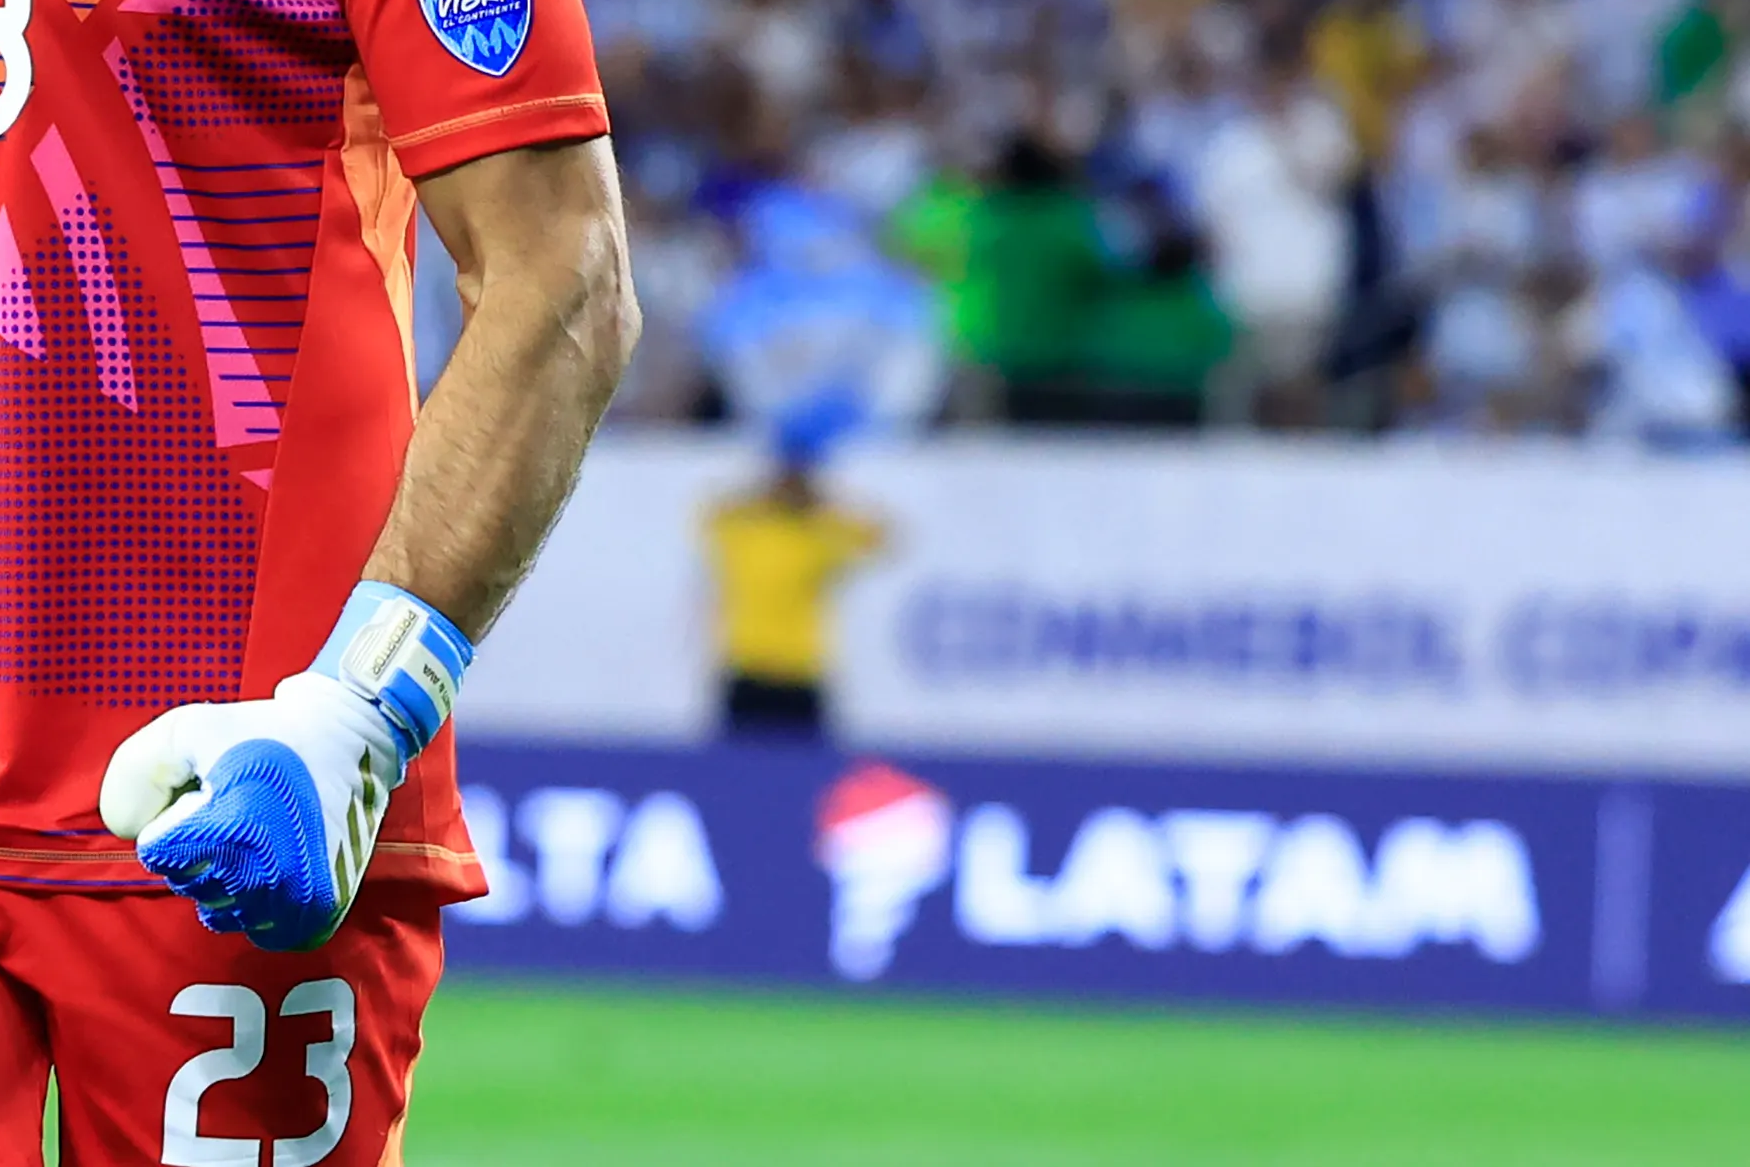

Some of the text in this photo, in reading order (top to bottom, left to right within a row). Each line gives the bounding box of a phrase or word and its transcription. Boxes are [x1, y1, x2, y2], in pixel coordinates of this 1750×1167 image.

[443, 1, 521, 29] EL CONTINENTE
[372, 608, 418, 675] PREDATOR
[422, 663, 440, 684] AVA
[955, 801, 1541, 963] LATAM
[161, 977, 356, 1167] 23
